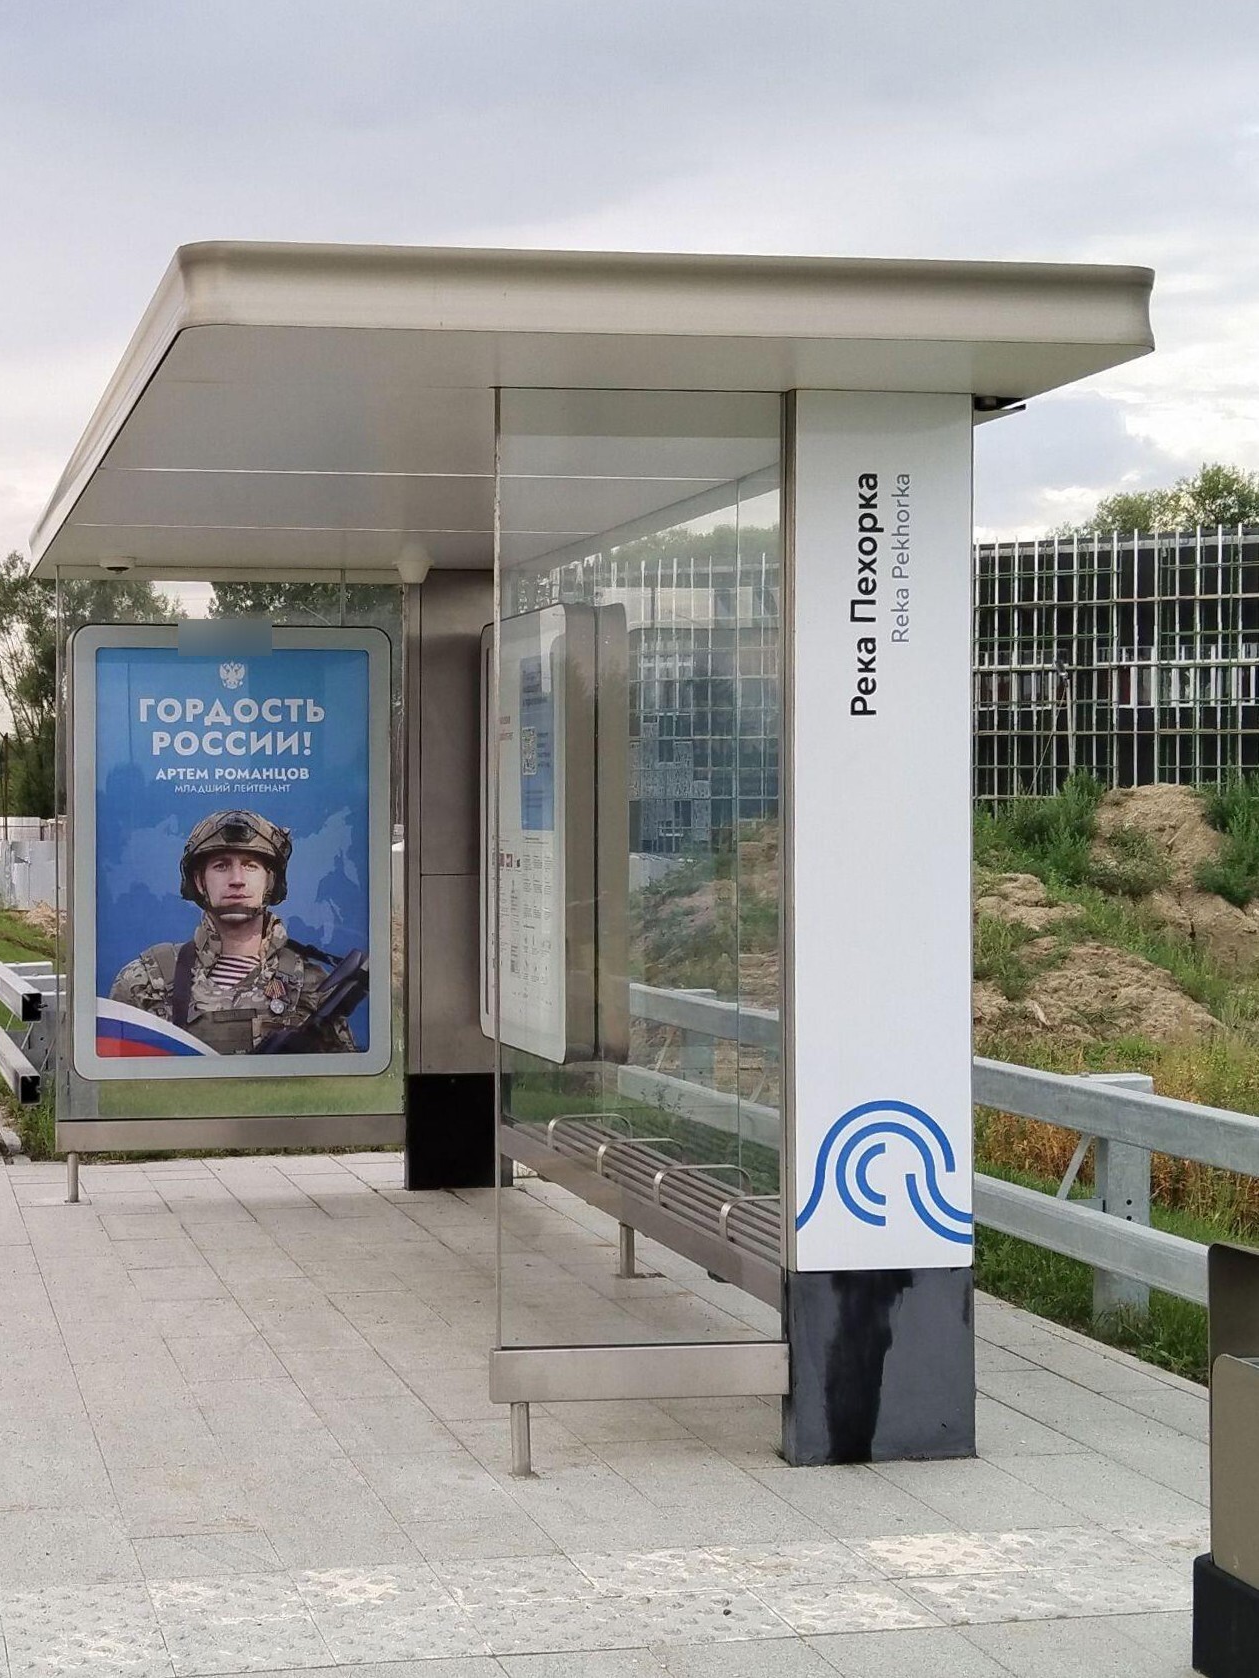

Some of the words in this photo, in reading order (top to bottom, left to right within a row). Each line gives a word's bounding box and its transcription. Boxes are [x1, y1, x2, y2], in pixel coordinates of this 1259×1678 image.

[891, 473, 911, 579] Pekhorka
[850, 472, 884, 623] Пехорка
[891, 588, 910, 643] Reka
[850, 636, 877, 716] Река
[139, 697, 325, 726] ГОРДОСТЬ
[152, 730, 312, 756] РОССИИ!
[155, 768, 209, 781] АРТЕМ
[214, 767, 310, 781] РОМАНЦОВ
[174, 782, 230, 794] МЛАДШИЙ
[233, 782, 291, 793] ЛЕЙТЕНАНТ
